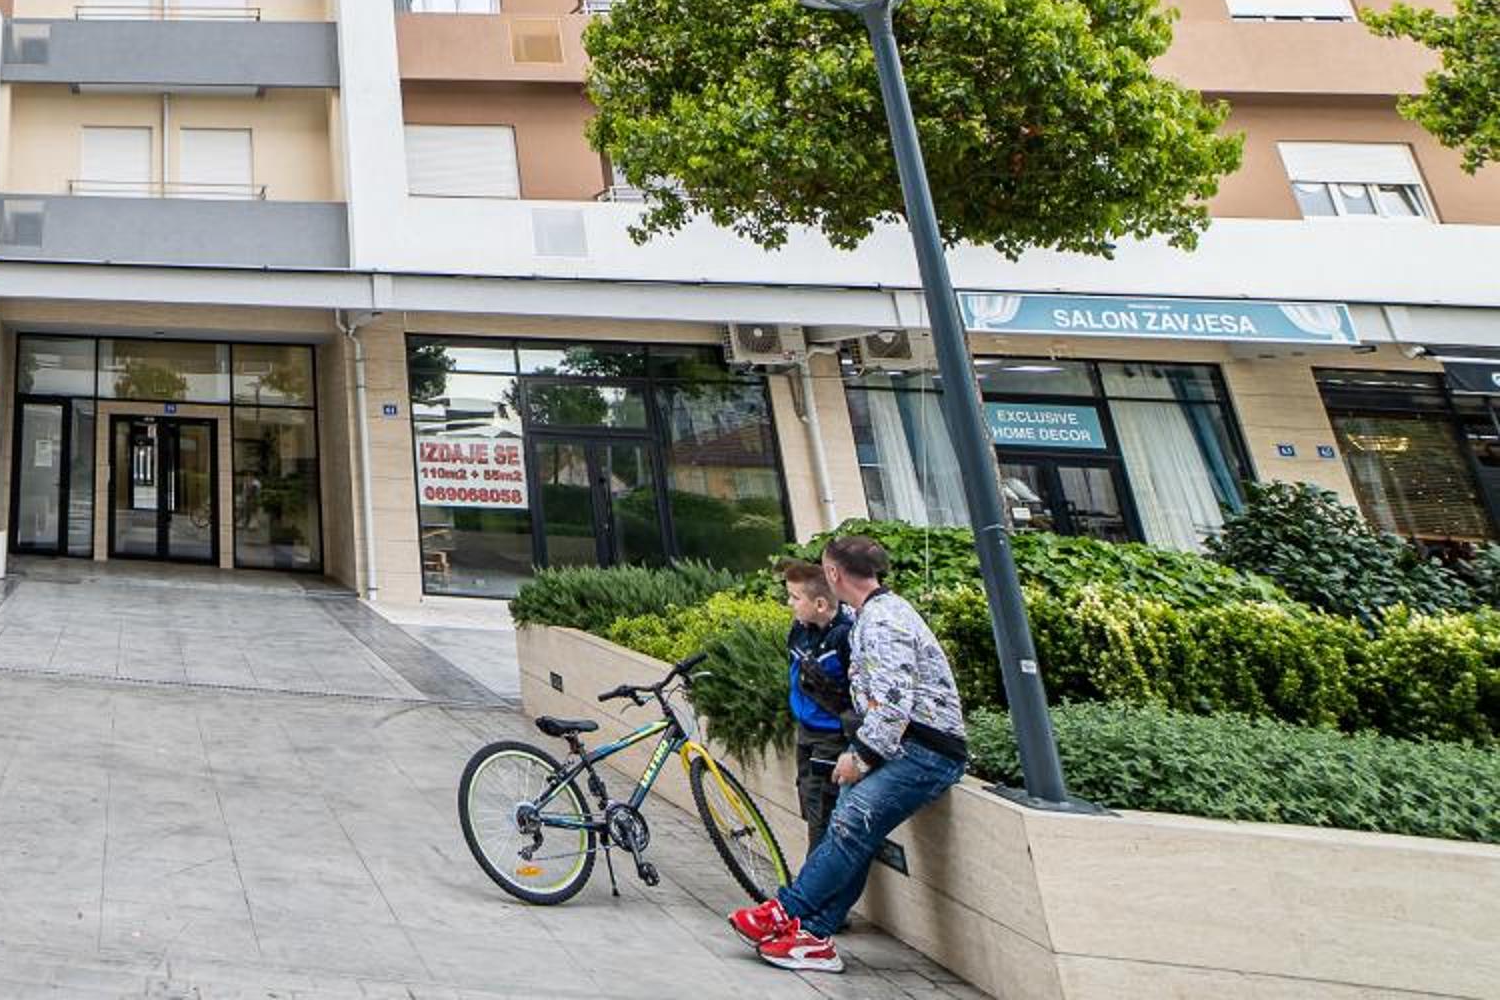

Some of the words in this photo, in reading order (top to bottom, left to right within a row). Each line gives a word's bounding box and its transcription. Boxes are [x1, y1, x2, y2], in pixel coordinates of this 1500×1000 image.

[1053, 309, 1138, 328] SALON
[1142, 311, 1257, 334] ZAVJESA
[997, 410, 1080, 425] EXCLUSIVE
[992, 426, 1036, 439] HOME
[1039, 428, 1092, 441] DECOR
[420, 442, 489, 464] IZDAJE
[493, 444, 519, 466] SE
[421, 467, 467, 480] 110m2
